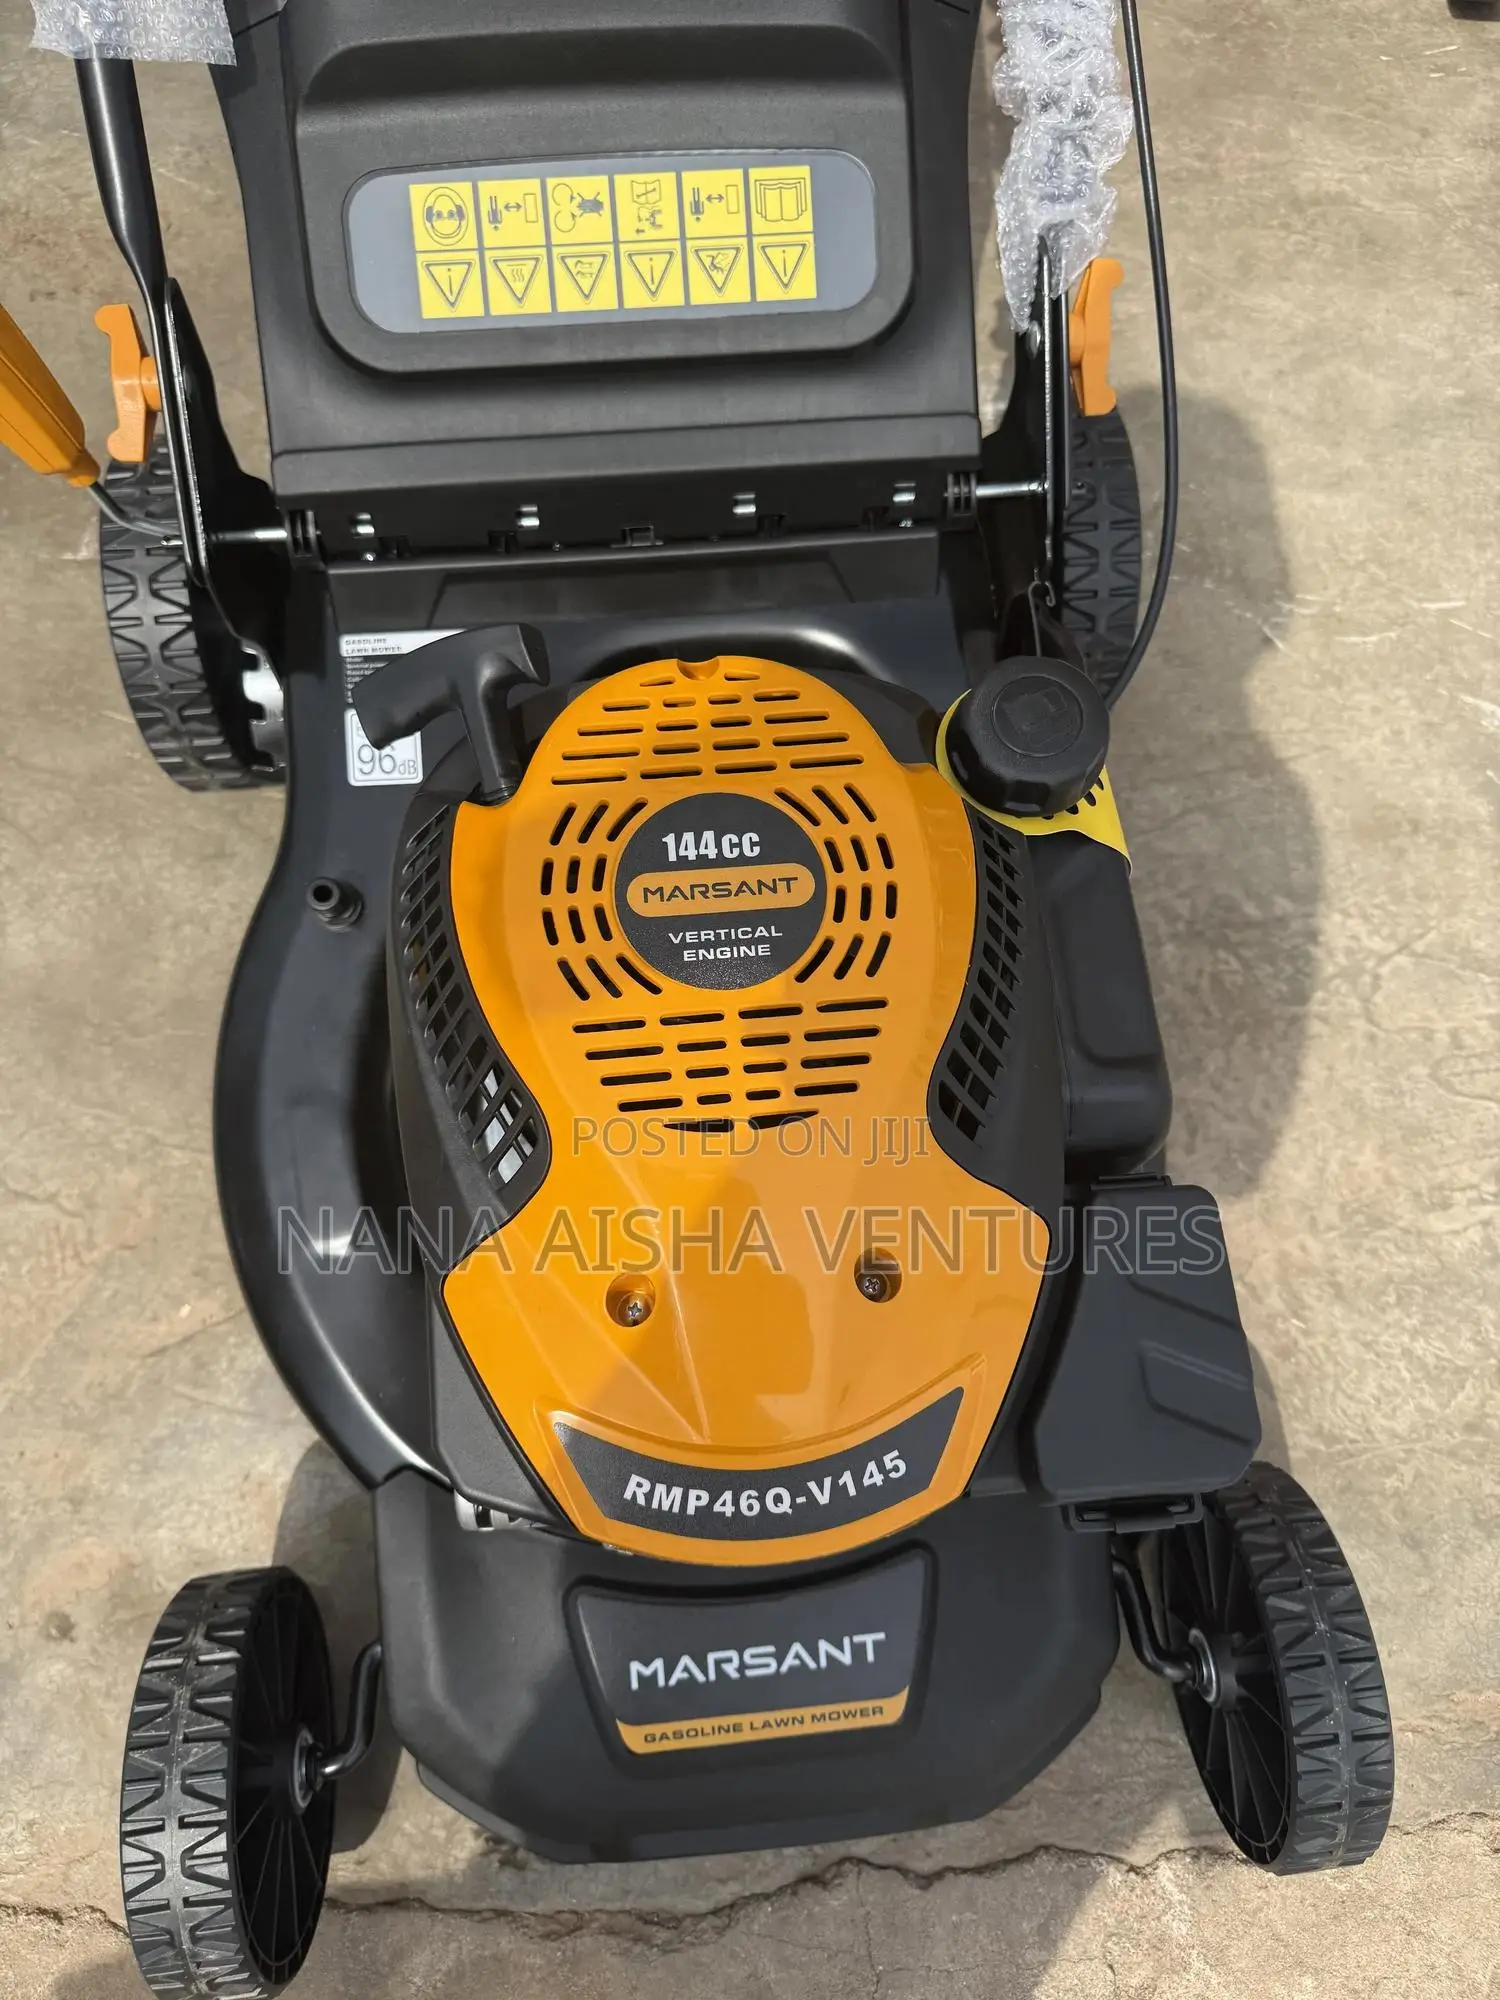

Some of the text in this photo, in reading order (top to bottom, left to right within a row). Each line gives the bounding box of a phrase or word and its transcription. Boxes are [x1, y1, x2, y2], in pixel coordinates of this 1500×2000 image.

[642, 876, 799, 904] MARSANT
[668, 925, 783, 944] VERTICAL
[683, 944, 771, 962] ENGINE
[623, 1449, 908, 1517] RMP46Q-V145
[629, 1631, 886, 1691] MARSANT
[644, 1705, 884, 1744] GASOLINE LAWN MOWER
